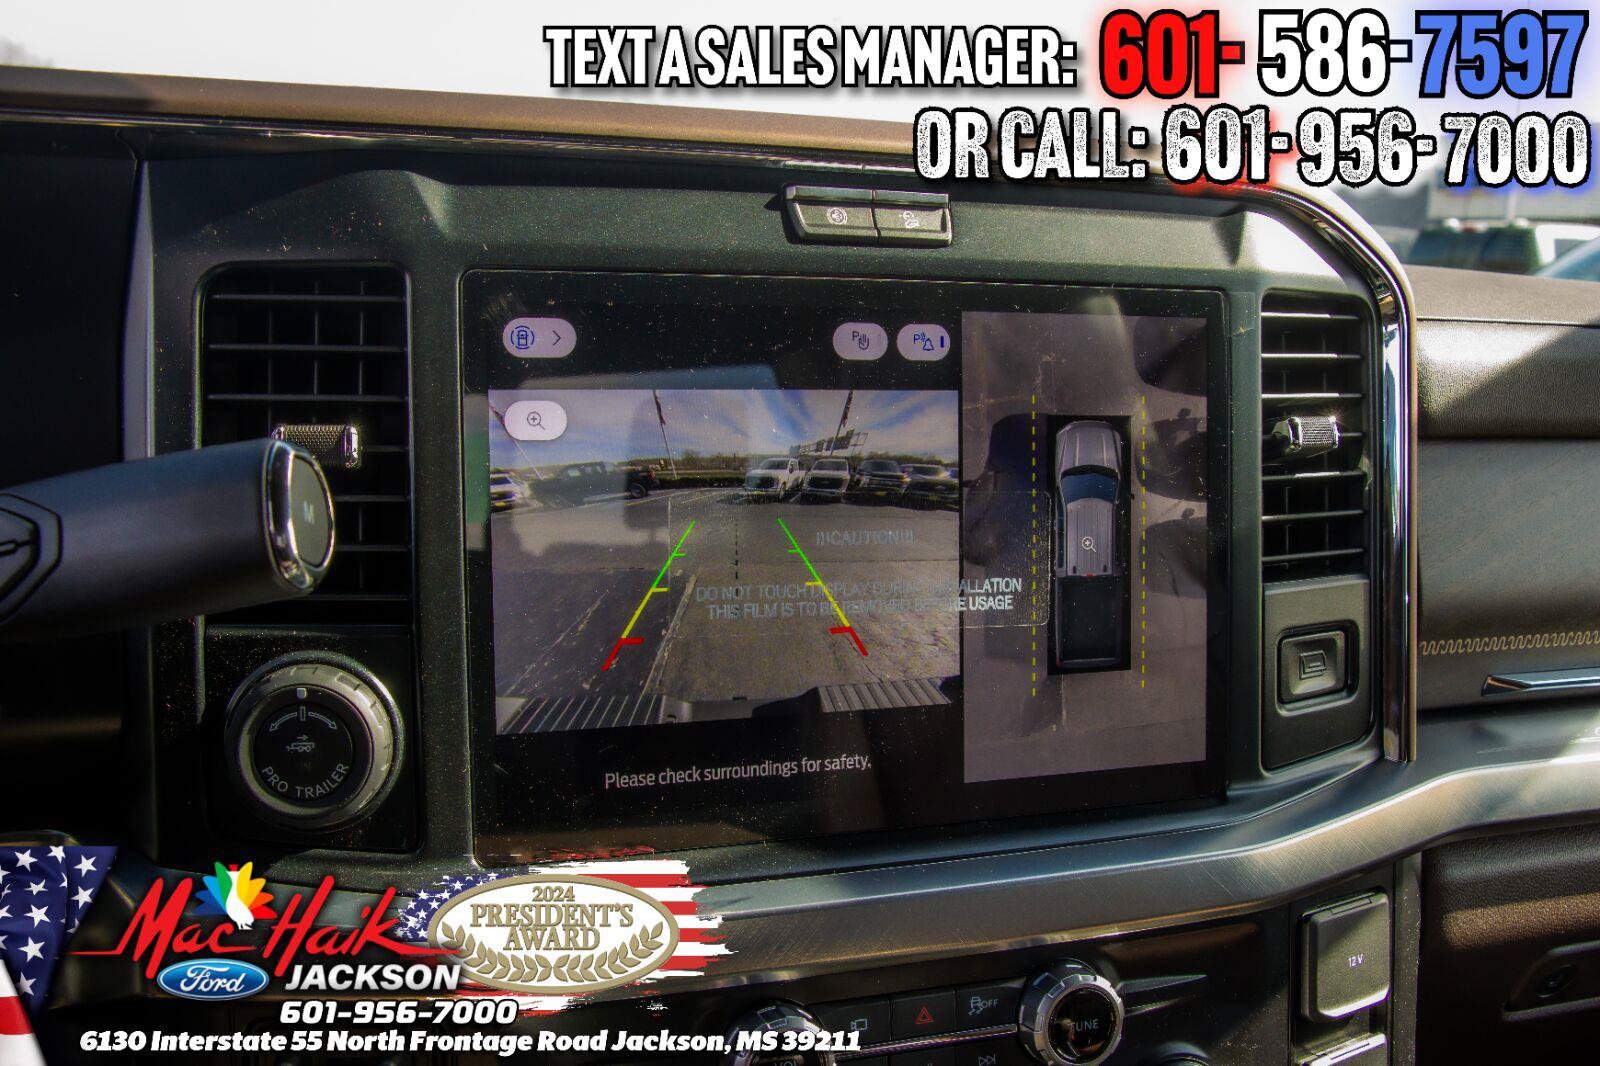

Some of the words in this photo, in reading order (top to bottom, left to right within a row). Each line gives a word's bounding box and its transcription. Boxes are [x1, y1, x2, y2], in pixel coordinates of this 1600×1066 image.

[696, 586, 718, 601] DO
[722, 584, 751, 600] NOT
[756, 583, 806, 599] TOUCH
[872, 580, 922, 596] DURIN
[706, 604, 739, 620] THIS
[743, 603, 777, 618] FILM
[781, 602, 795, 617] IS
[797, 601, 816, 616] TO
[969, 595, 1013, 611] USAGE
[262, 766, 289, 792] PRO
[295, 763, 349, 799] TRAILER
[605, 772, 655, 789] Please
[658, 766, 701, 784] check
[704, 759, 797, 781] surroundings
[801, 756, 822, 773] for
[824, 754, 872, 771] safety.
[1349, 953, 1364, 967] 12V
[980, 998, 999, 1009] OFF
[1068, 1019, 1100, 1031] TUNE
